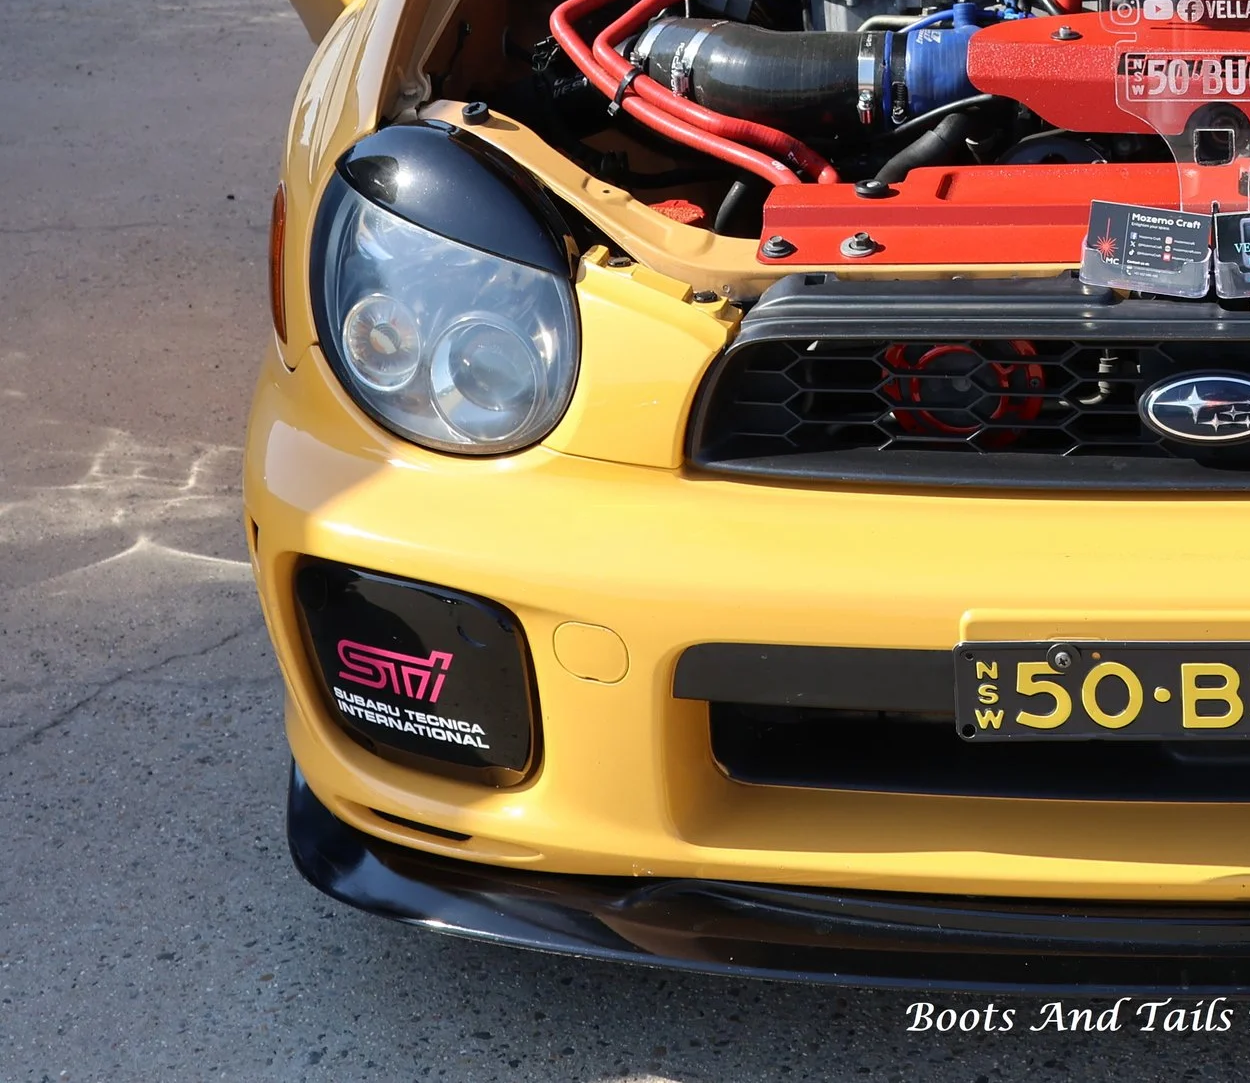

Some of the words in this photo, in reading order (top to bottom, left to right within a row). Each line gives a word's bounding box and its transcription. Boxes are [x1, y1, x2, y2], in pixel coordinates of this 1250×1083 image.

[1131, 213, 1175, 226] Mozemo
[1176, 219, 1201, 229] Craft
[1105, 257, 1119, 265] MC
[333, 686, 400, 718] SUBARU
[404, 709, 486, 736] TECNICA
[337, 699, 491, 749] INTERNATIONAL
